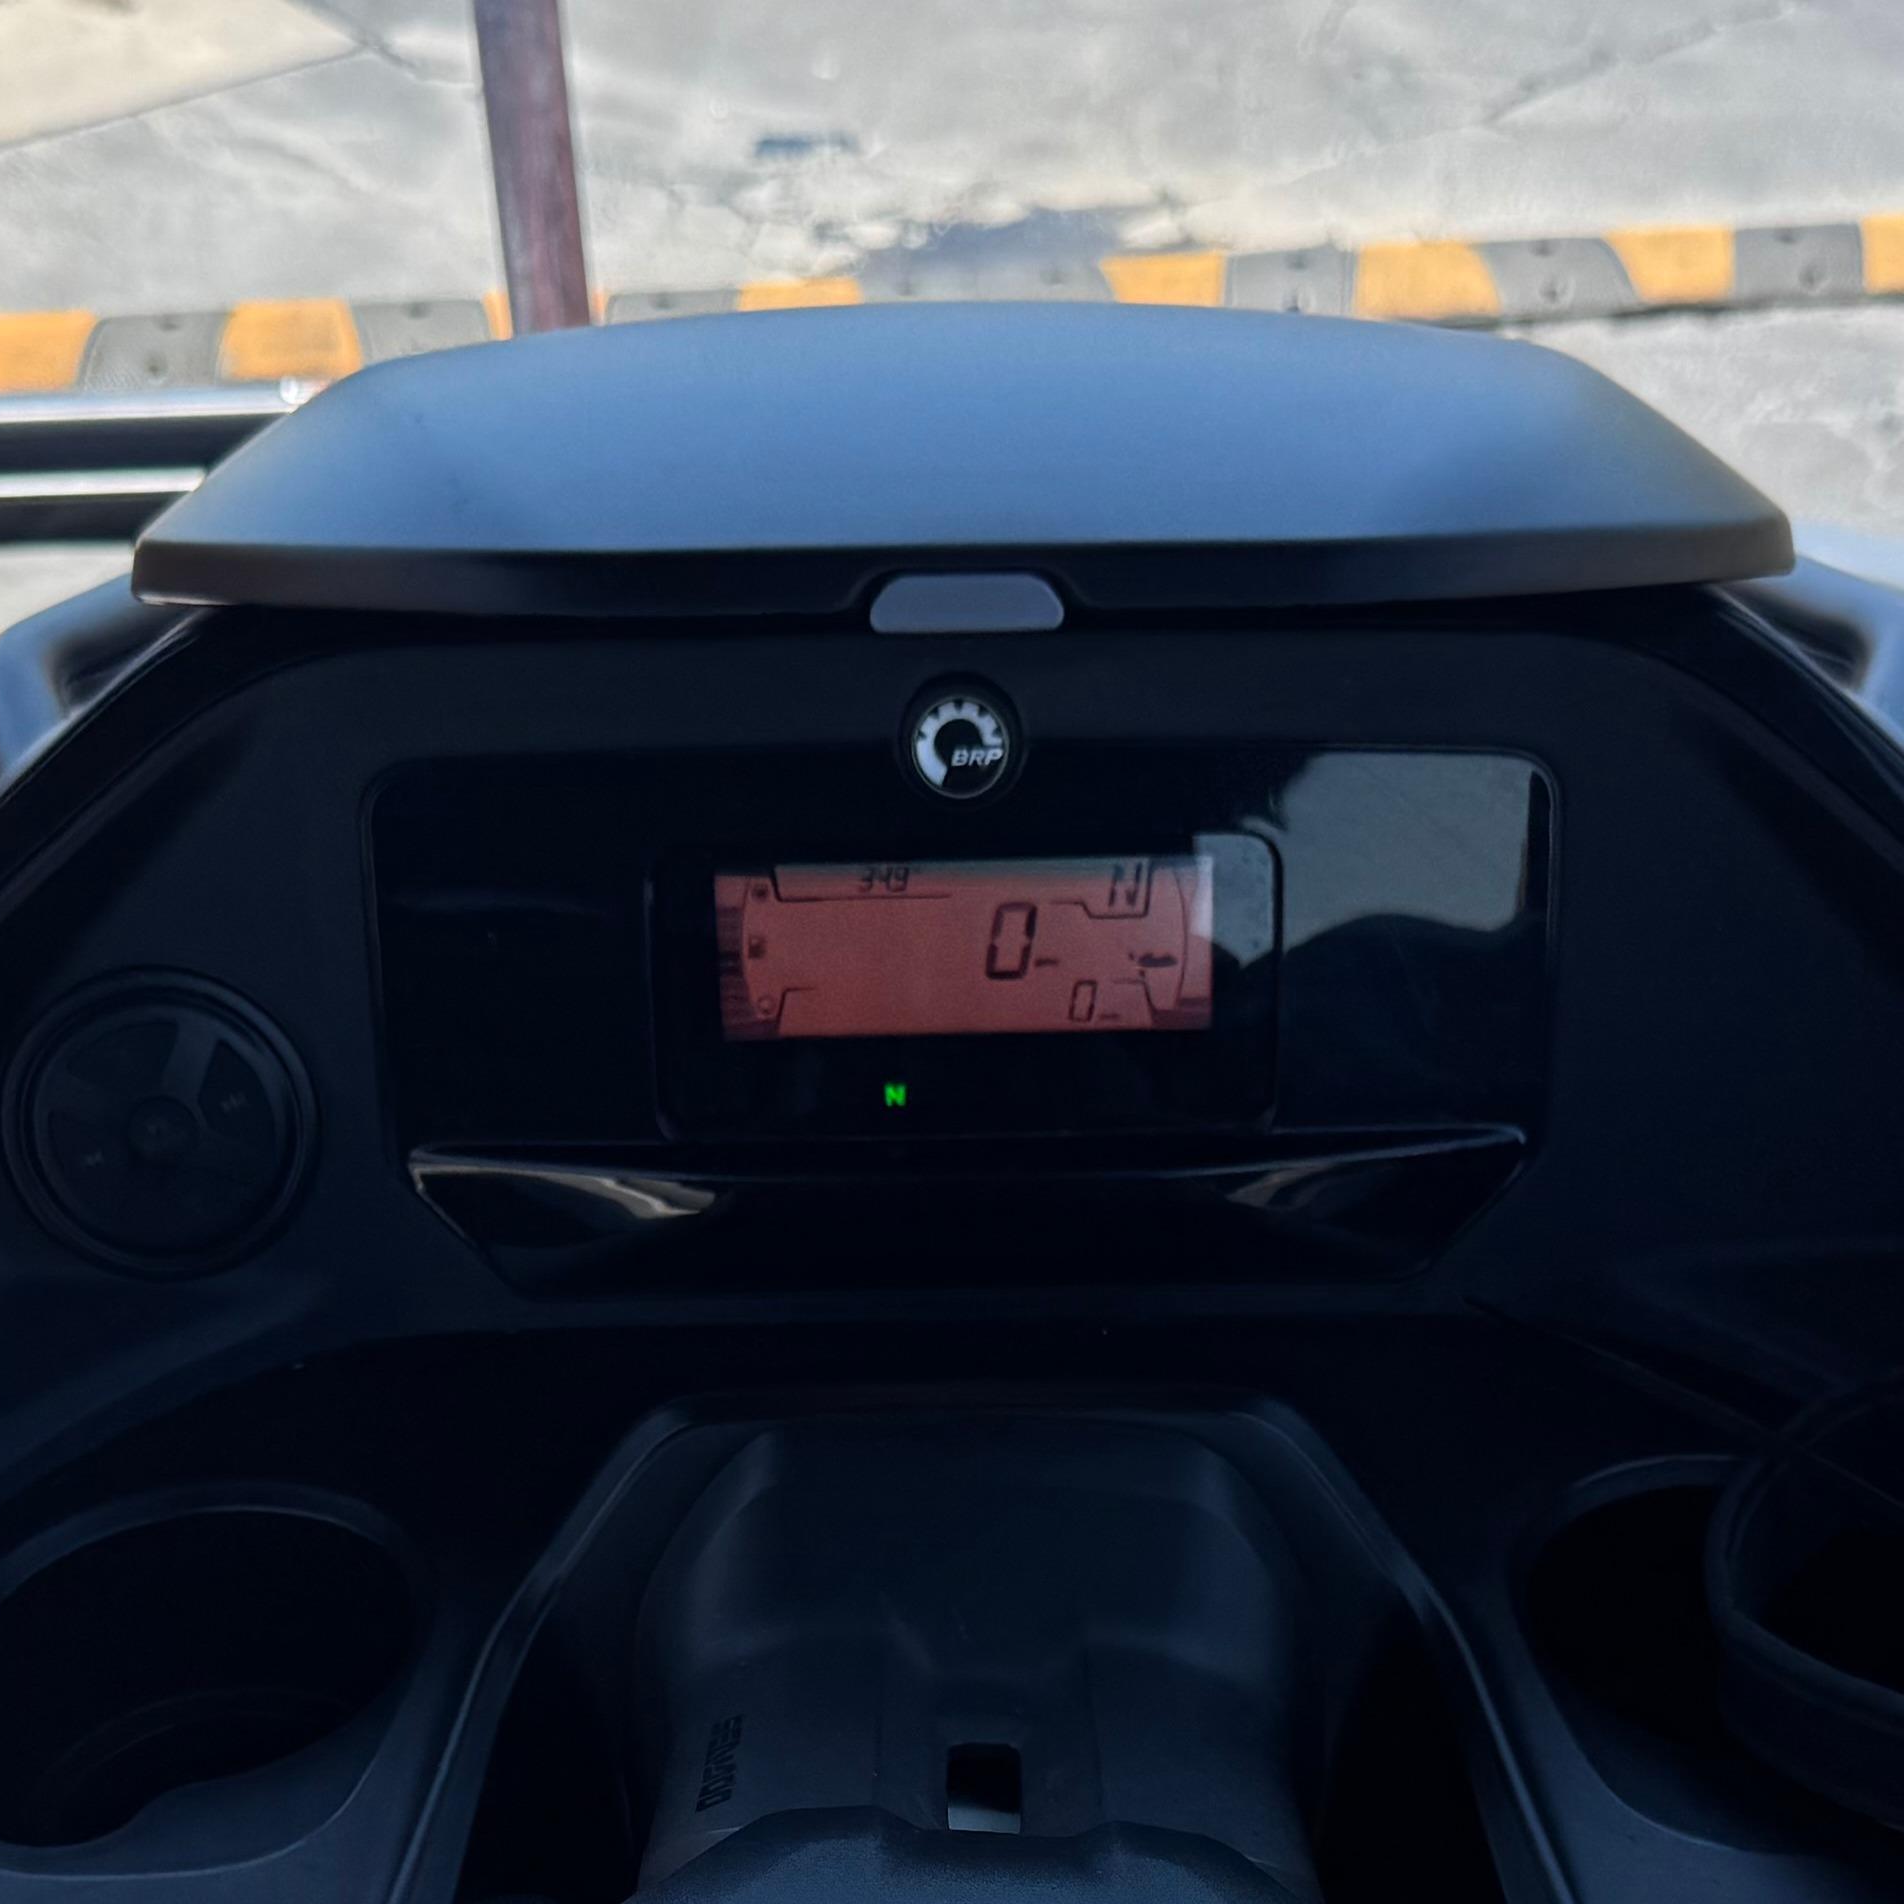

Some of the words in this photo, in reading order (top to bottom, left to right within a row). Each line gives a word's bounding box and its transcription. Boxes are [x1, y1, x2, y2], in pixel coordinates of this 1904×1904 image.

[951, 748, 1003, 767] BRP
[986, 902, 1037, 980] 0
[1068, 979, 1098, 1022] 0
[885, 1084, 906, 1106] N
